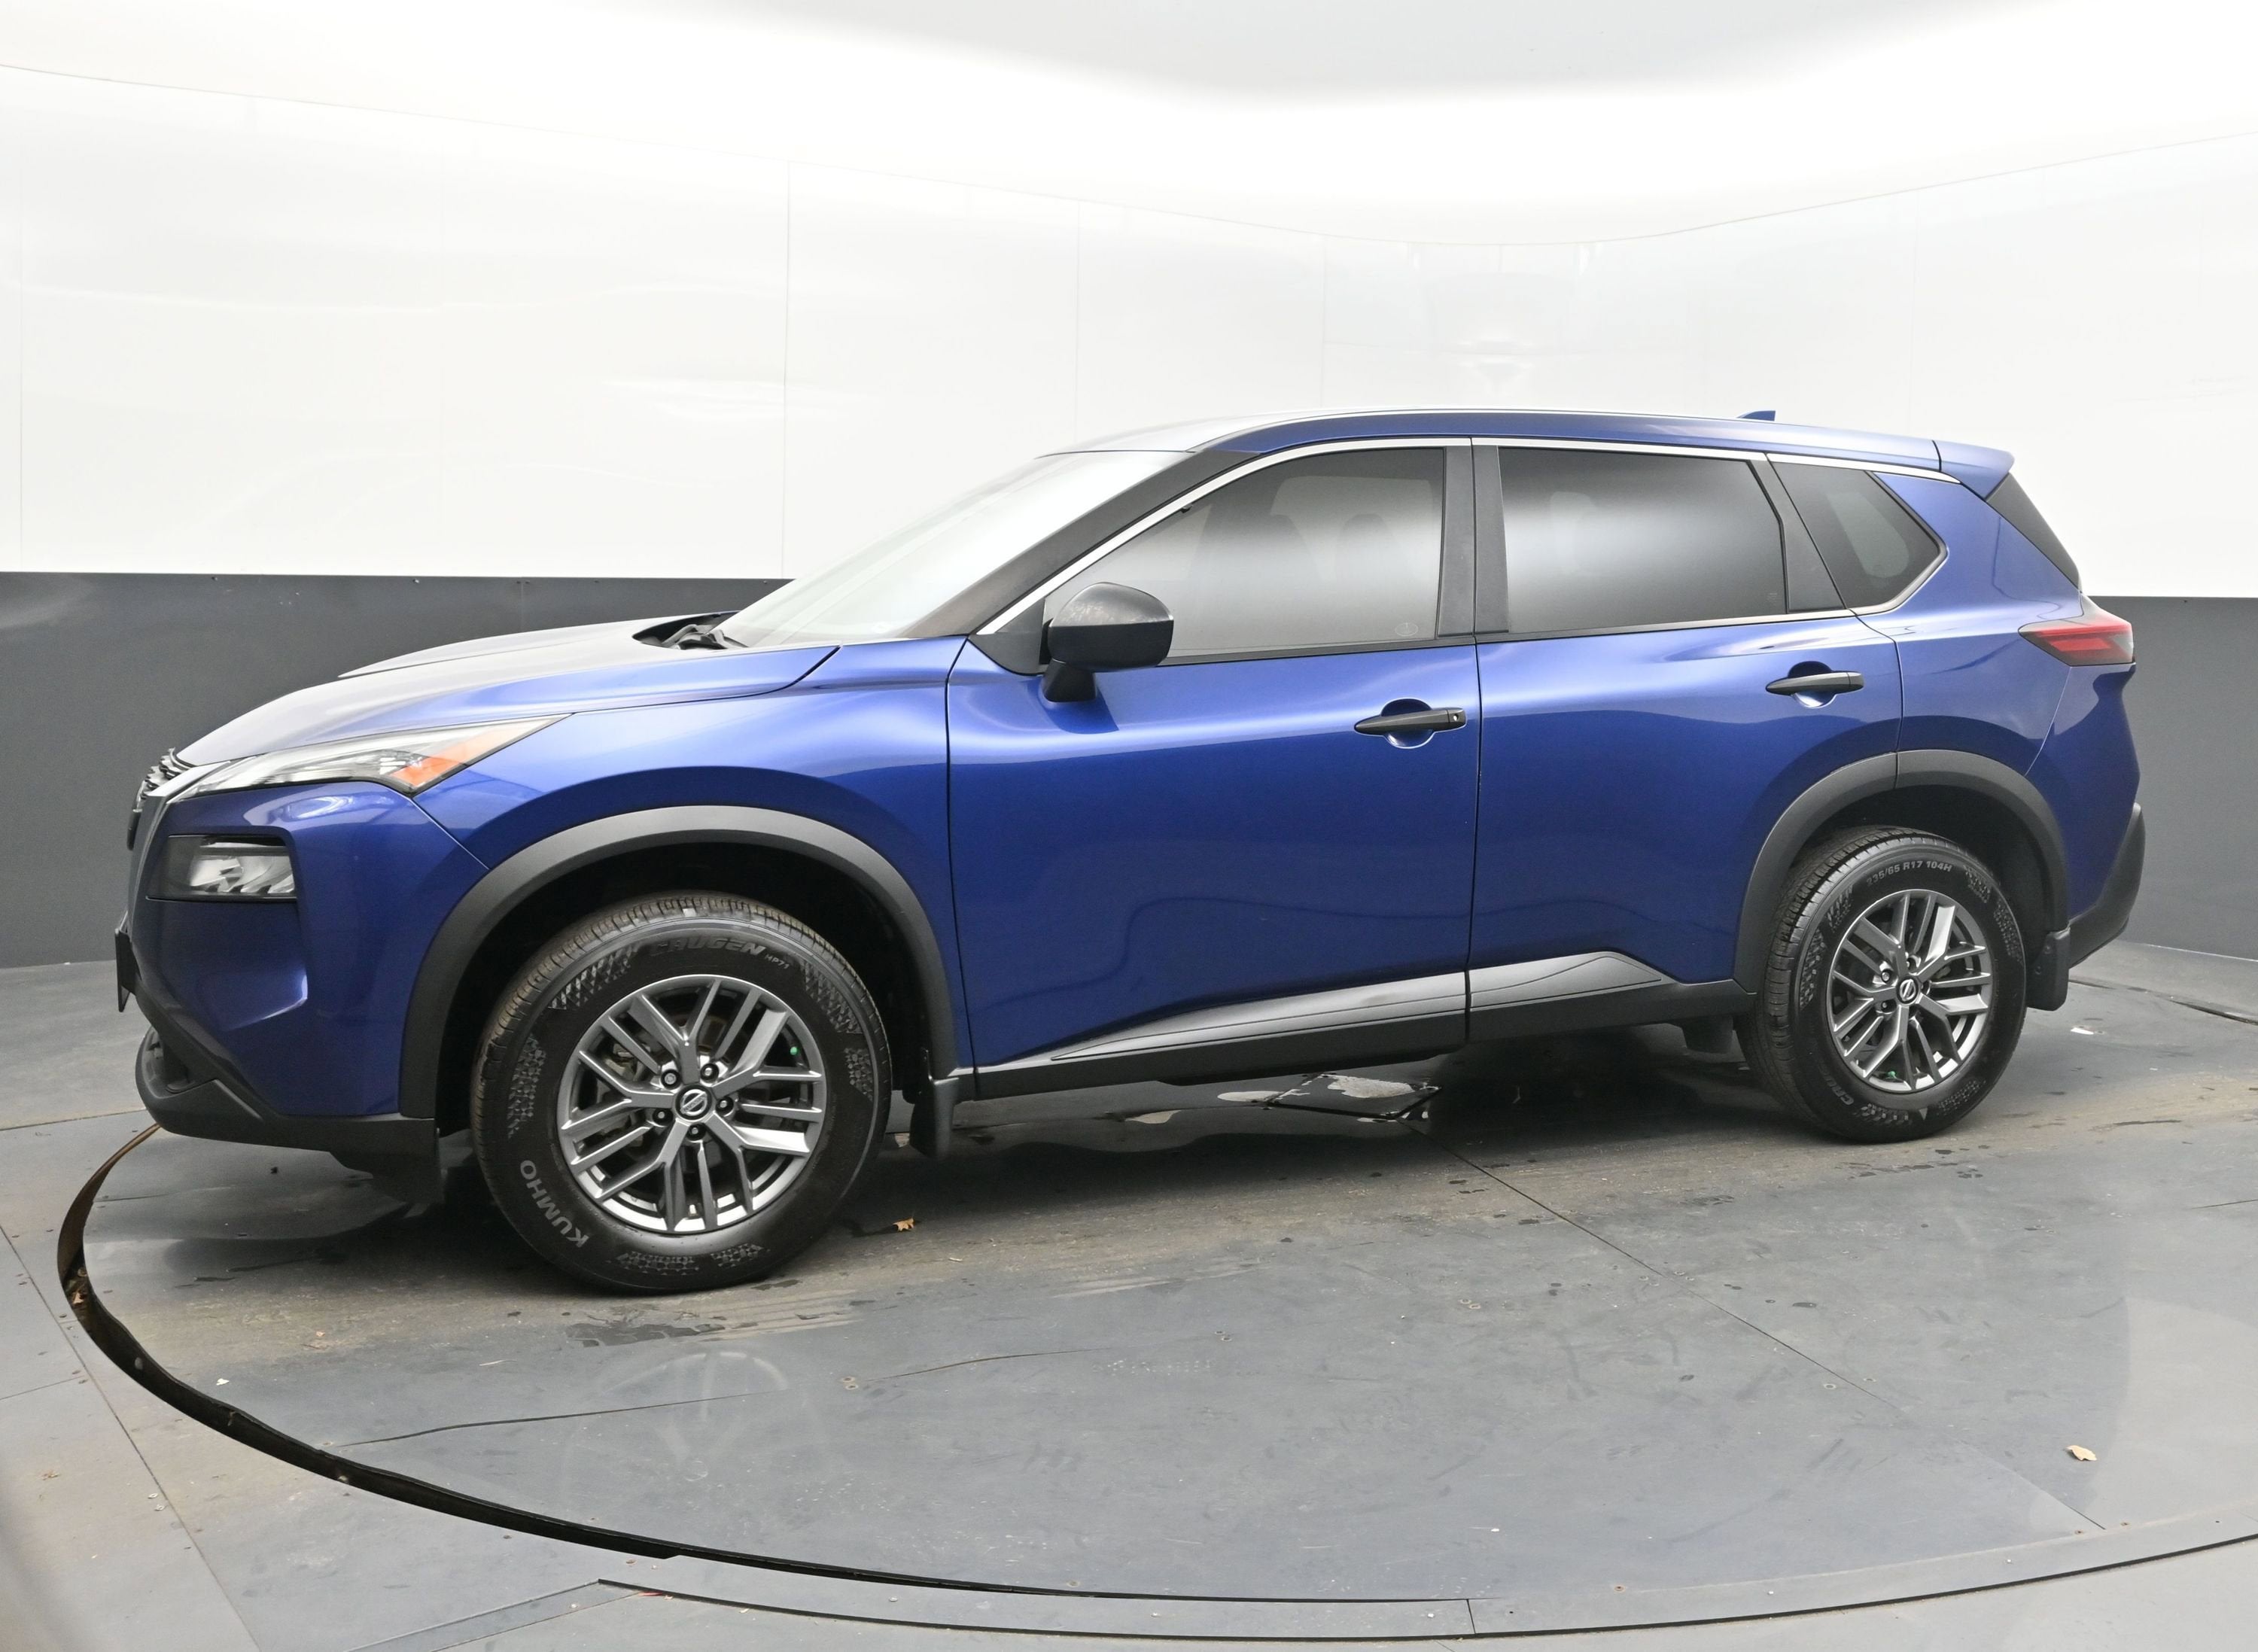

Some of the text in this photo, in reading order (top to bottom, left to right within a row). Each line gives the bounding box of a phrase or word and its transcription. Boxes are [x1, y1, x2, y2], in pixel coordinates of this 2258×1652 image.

[1867, 860, 1952, 886] 235/65 R17 104H
[520, 1160, 589, 1247] KUMHO
